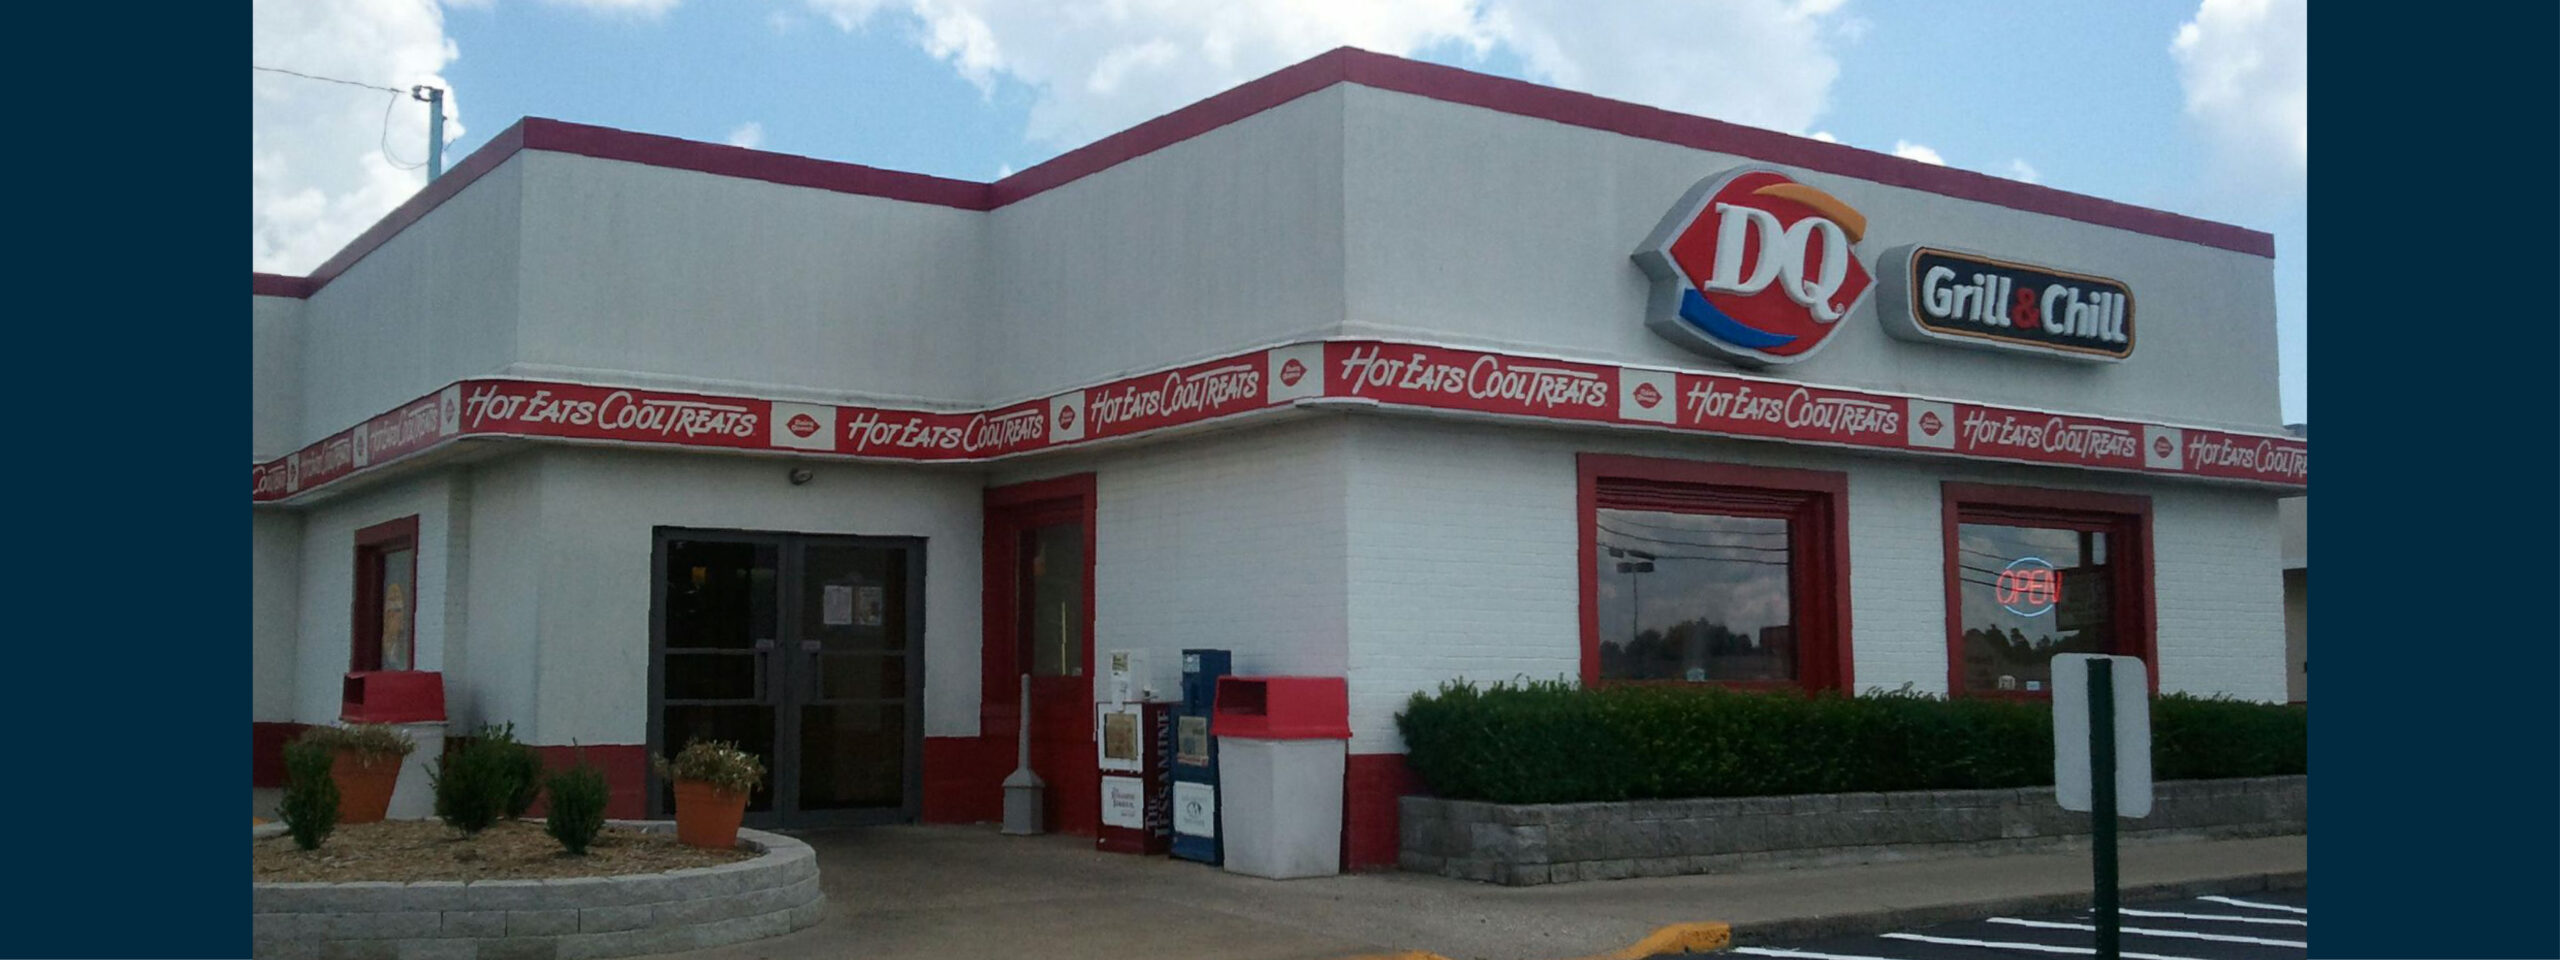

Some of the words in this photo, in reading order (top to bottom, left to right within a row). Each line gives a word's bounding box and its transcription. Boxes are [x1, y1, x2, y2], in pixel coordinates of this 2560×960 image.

[1703, 202, 1849, 324] DQ
[1922, 265, 2011, 328] Grill
[2012, 287, 2040, 330] &
[2040, 283, 2129, 344] Chill
[1341, 345, 1404, 394] HOT
[1399, 353, 1466, 393] EATS
[1467, 355, 1525, 399] COOL
[1507, 365, 1608, 408] TREATS
[467, 385, 525, 428] HOT
[519, 390, 594, 425] EATS
[598, 390, 666, 430] COOL
[643, 399, 757, 437] TREATS
[848, 413, 902, 451] HOT
[896, 417, 962, 449] EATS
[962, 413, 1000, 451] COOL
[990, 409, 1044, 449] TREATS
[1687, 381, 1733, 424] HOT
[1729, 386, 1783, 422] EATS
[1784, 387, 1831, 428] COOL
[1816, 397, 1898, 435] TREATS
[1996, 569, 2063, 605] OPEN
